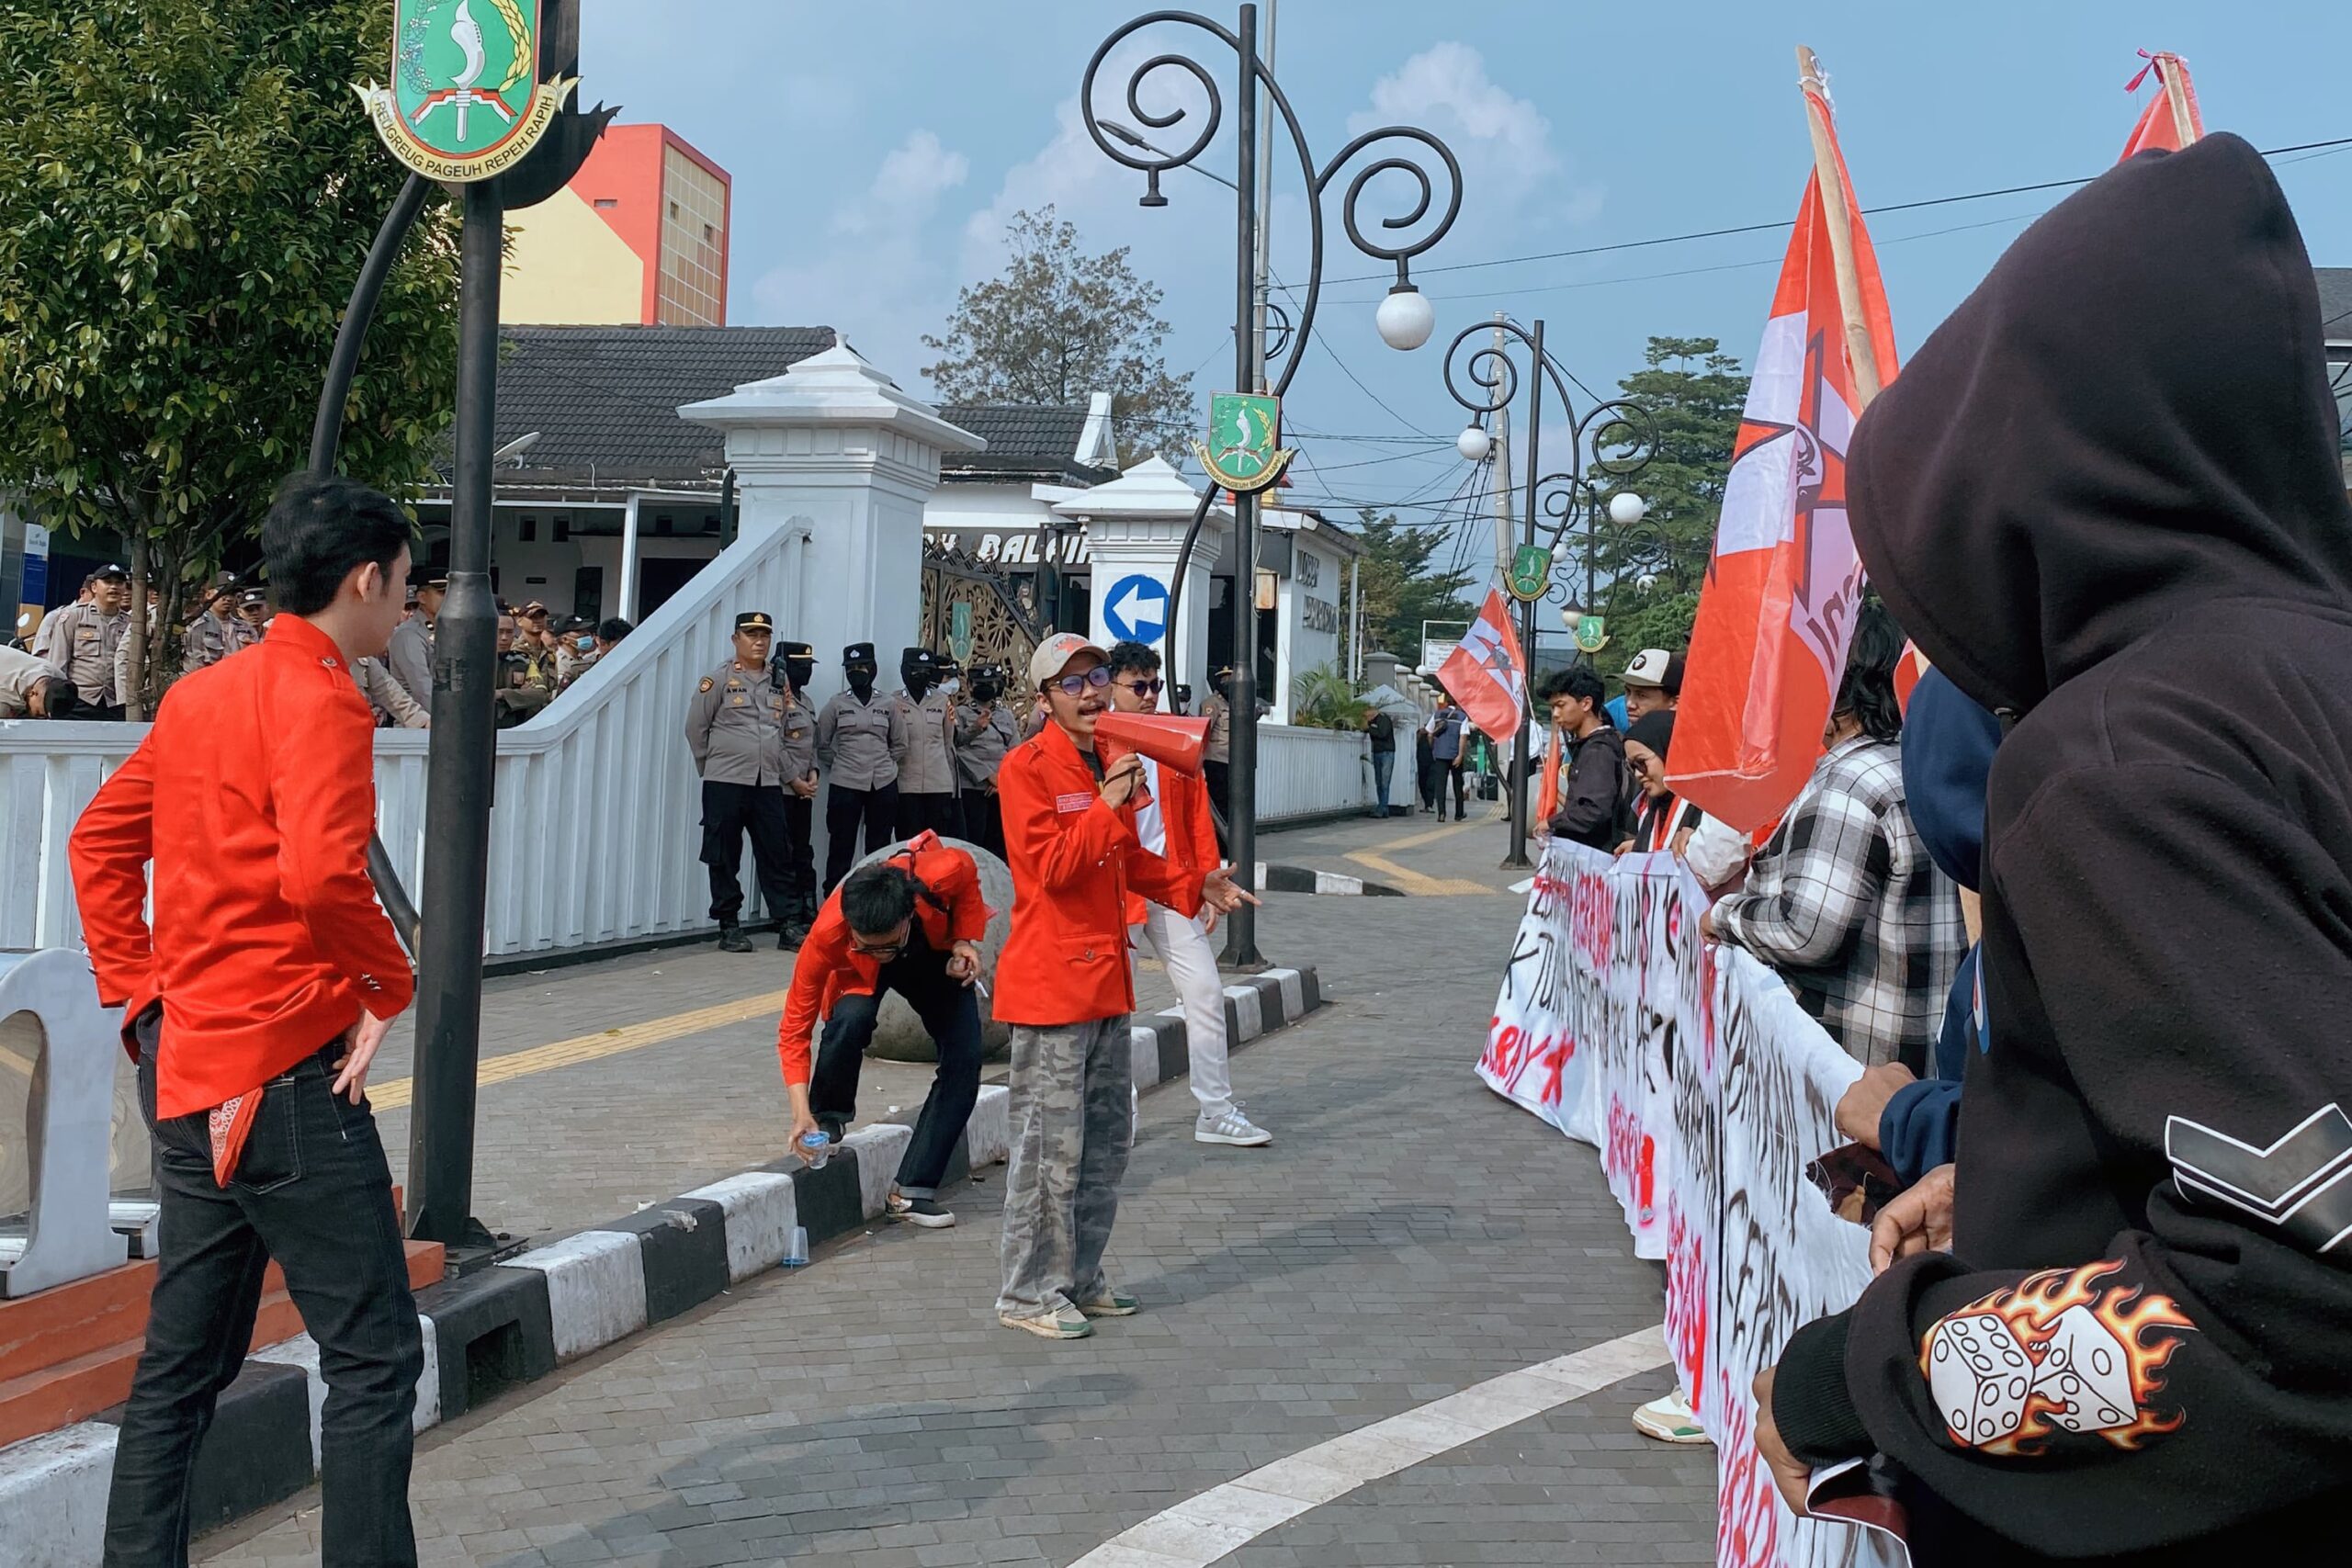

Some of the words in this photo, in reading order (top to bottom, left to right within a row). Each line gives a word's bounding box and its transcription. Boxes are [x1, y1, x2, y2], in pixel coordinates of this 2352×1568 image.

[376, 100, 425, 167] REUGREUG
[425, 160, 482, 177] PAGEUH
[485, 136, 530, 173] REPEH
[525, 96, 553, 140] RAPIH
